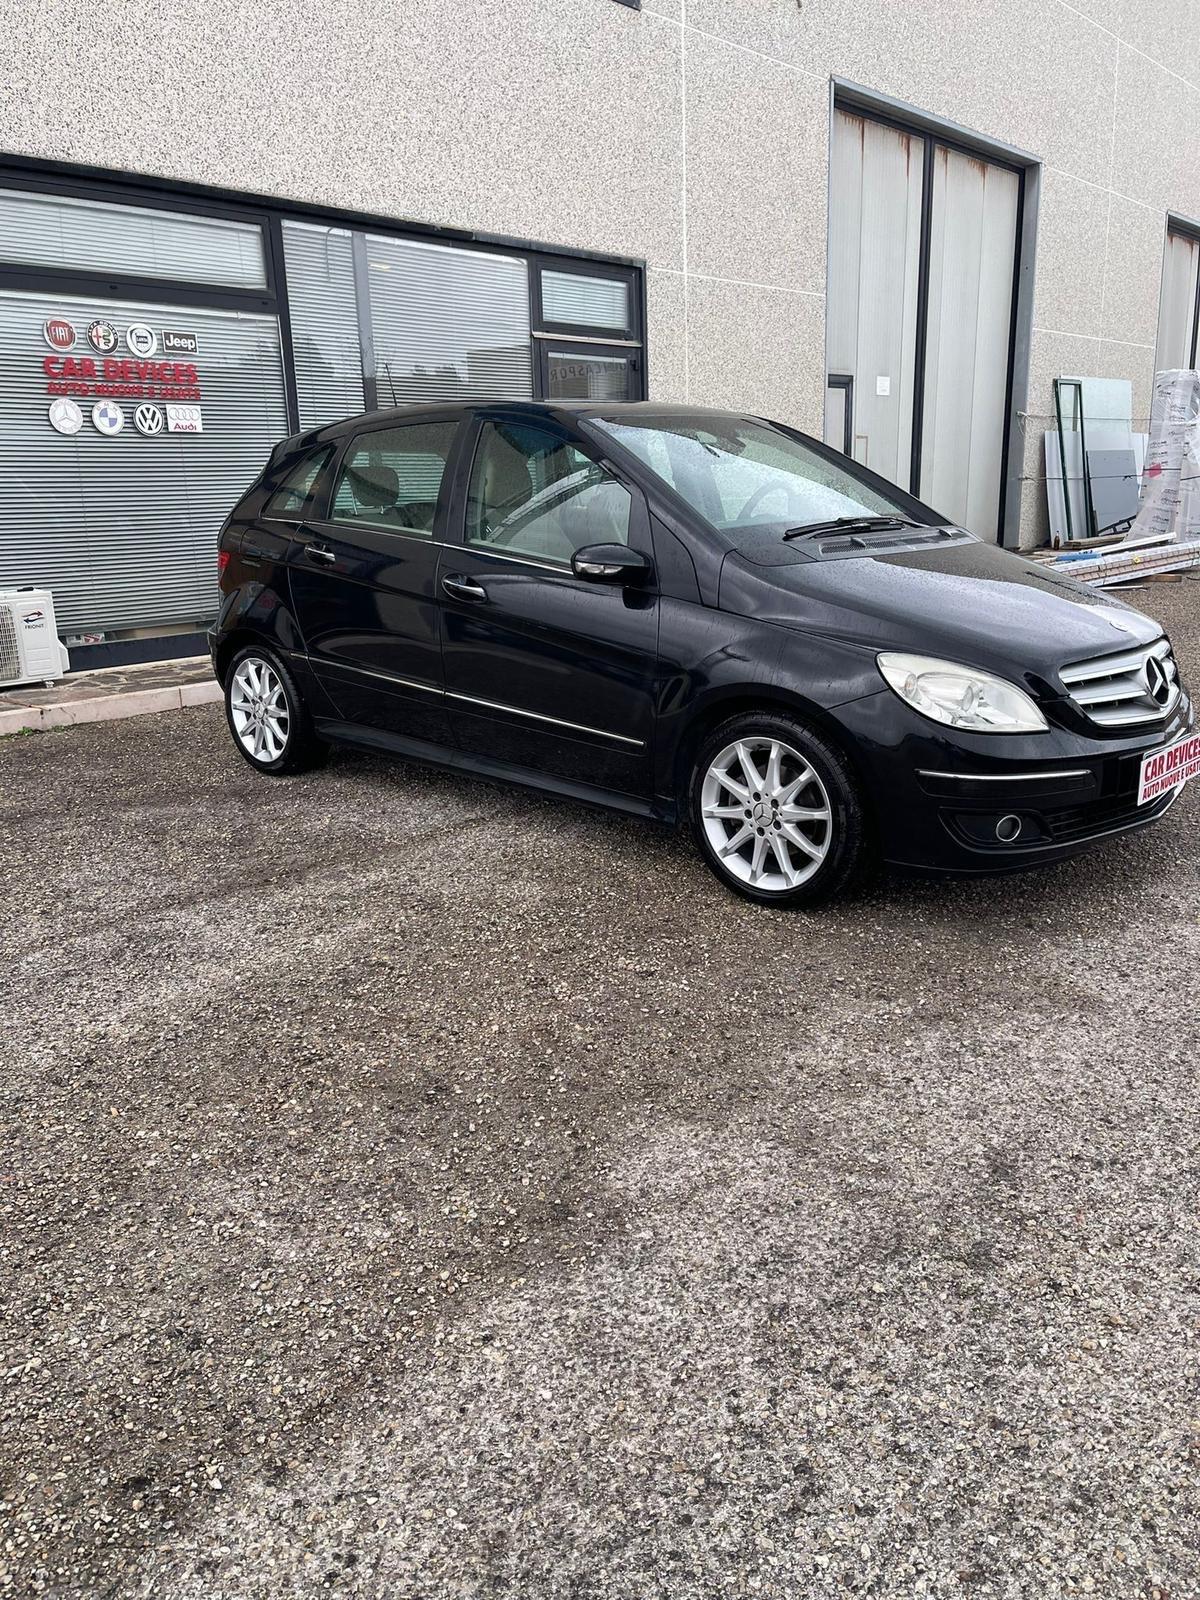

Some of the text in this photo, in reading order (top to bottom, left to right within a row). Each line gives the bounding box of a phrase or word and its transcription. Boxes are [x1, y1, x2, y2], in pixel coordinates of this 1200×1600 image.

[51, 326, 70, 342] FIAT
[166, 336, 196, 350] Jeep
[43, 356, 198, 385] CAR DEVICES
[47, 381, 90, 396] AUTO
[94, 383, 145, 397] NUOVE
[148, 386, 156, 397] E
[173, 423, 197, 431] Audi
[1145, 755, 1165, 782] CAR
[1142, 781, 1160, 801] AUTO
[1161, 772, 1180, 790] NUOVE
[1185, 762, 1200, 778] USAT
